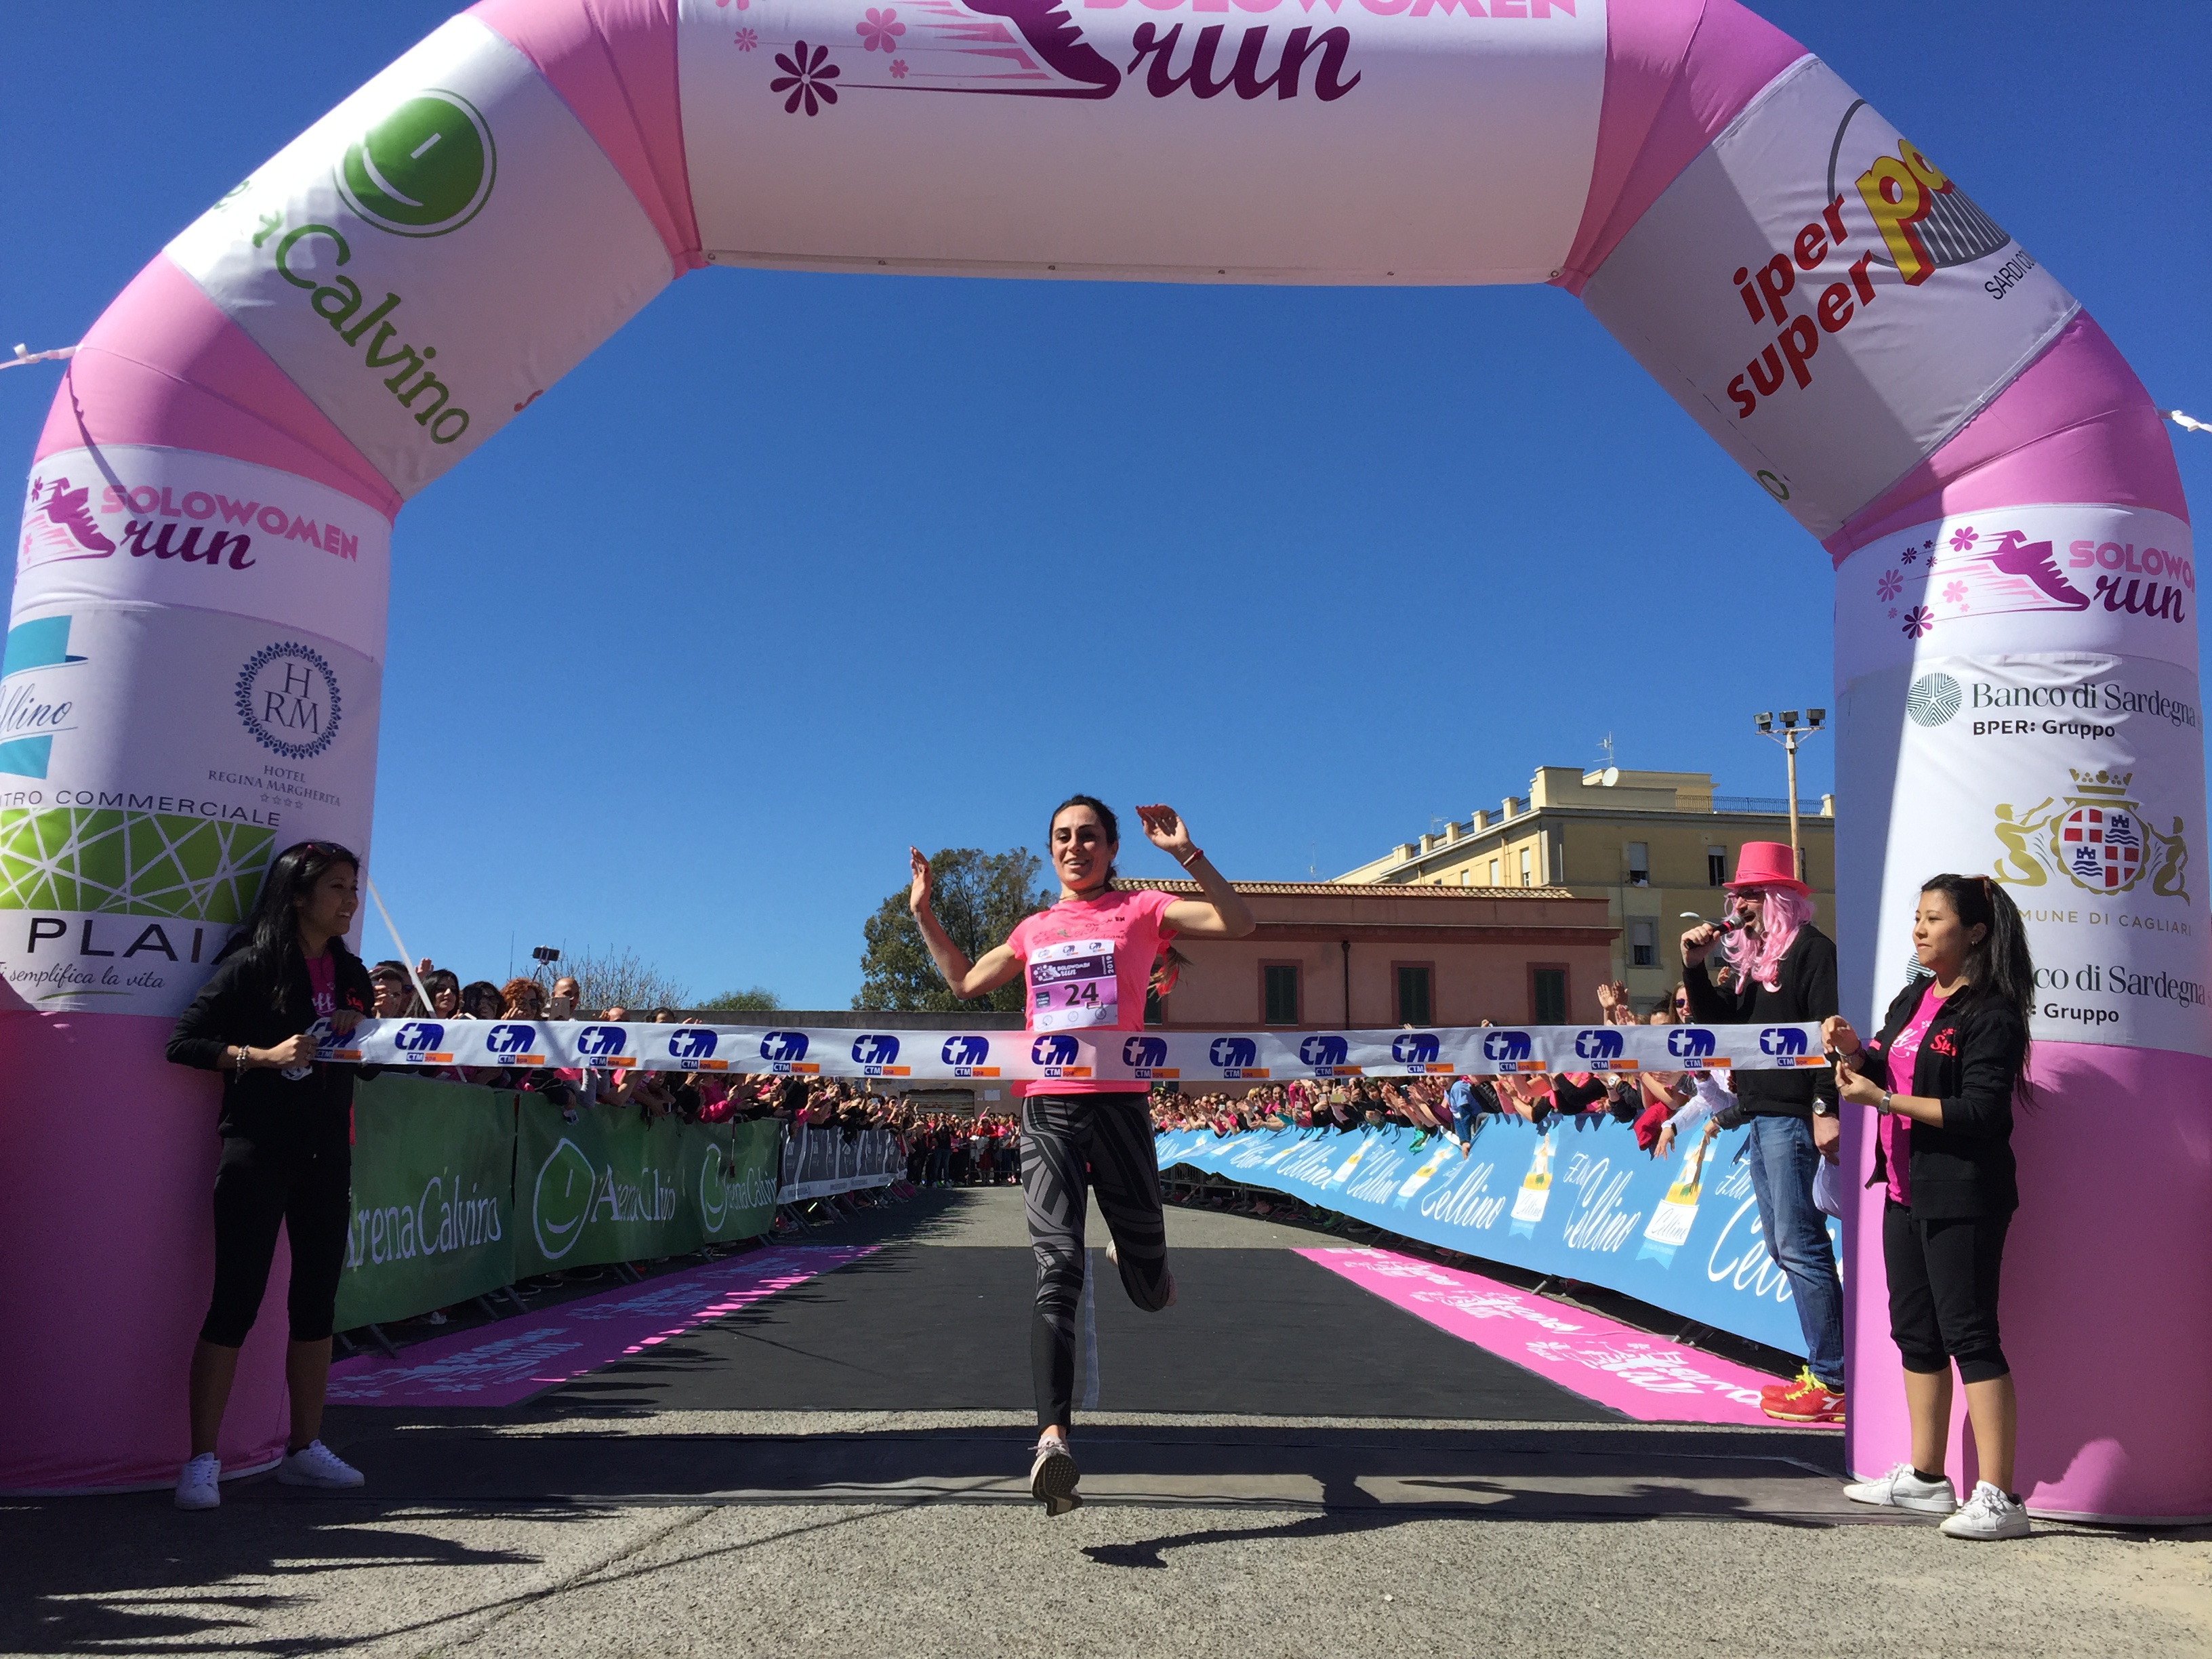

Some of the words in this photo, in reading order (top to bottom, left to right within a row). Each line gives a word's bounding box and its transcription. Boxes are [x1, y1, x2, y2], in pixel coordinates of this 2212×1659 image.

[1127, 22, 1361, 101] run
[1733, 193, 1848, 325] iper
[253, 209, 469, 445] Calvino
[1727, 249, 1877, 419] super
[100, 485, 359, 562] SOLOWOMEN
[119, 520, 256, 570] run
[2069, 540, 2195, 593] SOLOWO
[2093, 575, 2186, 623] run
[283, 661, 311, 699] H
[1972, 682, 2066, 709] Banco
[2072, 683, 2097, 709] di
[2104, 683, 2195, 728] Sardegna
[1973, 719, 2036, 736] BPER:
[2042, 719, 2115, 740] Gruppo
[208, 770, 263, 787] REGINA
[266, 780, 341, 807] MARGHERITA
[264, 764, 306, 783] HOTEL
[56, 790, 281, 827] COMMERCIALE
[2018, 910, 2078, 922] MUNE
[2089, 912, 2109, 924] DI
[2118, 915, 2192, 936] CAGLIARI
[9, 963, 95, 987] semplifica
[101, 966, 119, 985] la
[126, 971, 165, 988] vita
[1063, 982, 1099, 1007] 24
[2076, 964, 2102, 991] di
[2109, 966, 2206, 1008] Sardegna
[2044, 1003, 2119, 1025] Gruppo
